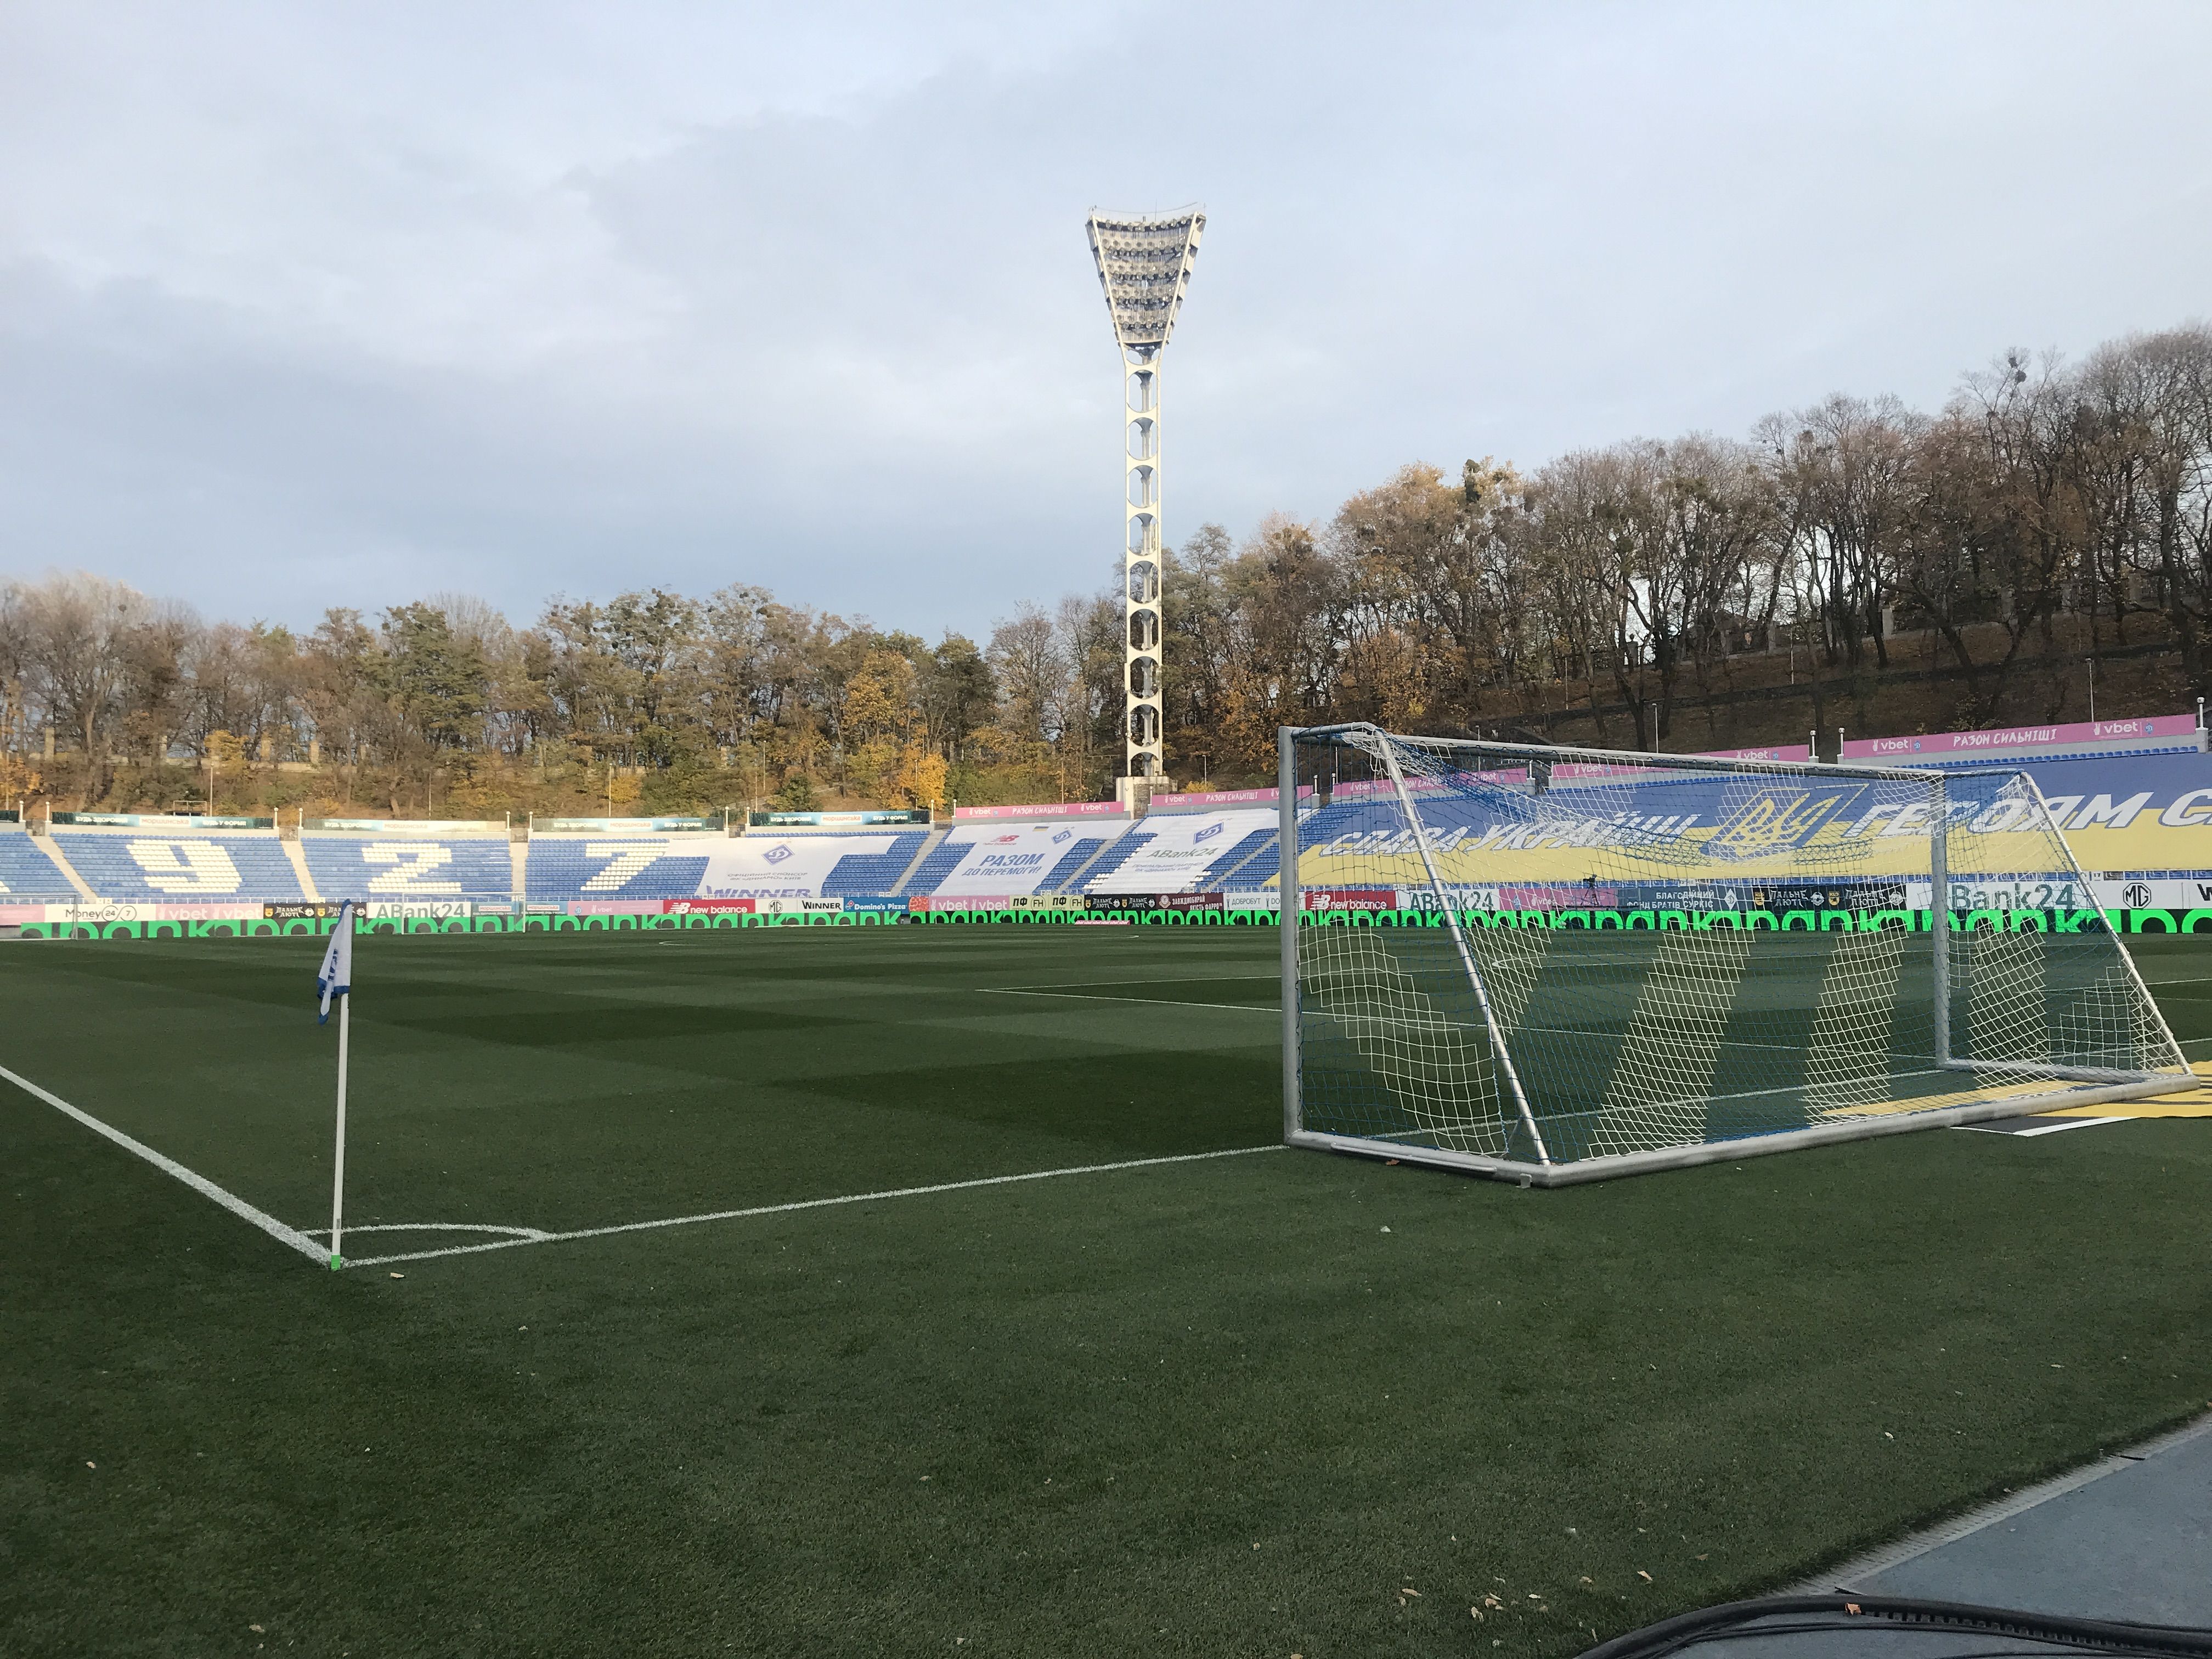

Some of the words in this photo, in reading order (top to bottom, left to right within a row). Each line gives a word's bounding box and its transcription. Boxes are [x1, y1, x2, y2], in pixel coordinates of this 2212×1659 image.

[2104, 721, 2138, 733] vbet
[1881, 740, 1909, 750] vbet
[1743, 750, 1769, 759] vbet
[1147, 847, 1219, 859] ABank24
[979, 853, 1046, 867] РАЗОМ
[362, 843, 462, 893] 2
[580, 842, 671, 890] 7
[962, 868, 983, 876] ДО
[980, 866, 1043, 876] ПЕРЕМОГИ!
[706, 885, 814, 898] WINNER
[1656, 889, 1714, 900] БЛАГОДІЙНИЙ
[1952, 884, 2076, 910] Bank24
[2125, 884, 2149, 907] MG
[376, 902, 465, 918] ABank24
[710, 906, 748, 914] balance
[769, 900, 782, 913] MG
[802, 900, 842, 910] WINNER
[939, 899, 968, 911] vbet
[979, 899, 1008, 911] vbet
[1331, 901, 1348, 910] new
[1349, 899, 1387, 910] balance
[1652, 901, 1680, 910] БРАТІВ
[1683, 901, 1713, 909] СУРКІС
[65, 909, 102, 918] Money
[168, 907, 207, 919] vbet
[223, 907, 262, 919] vbet
